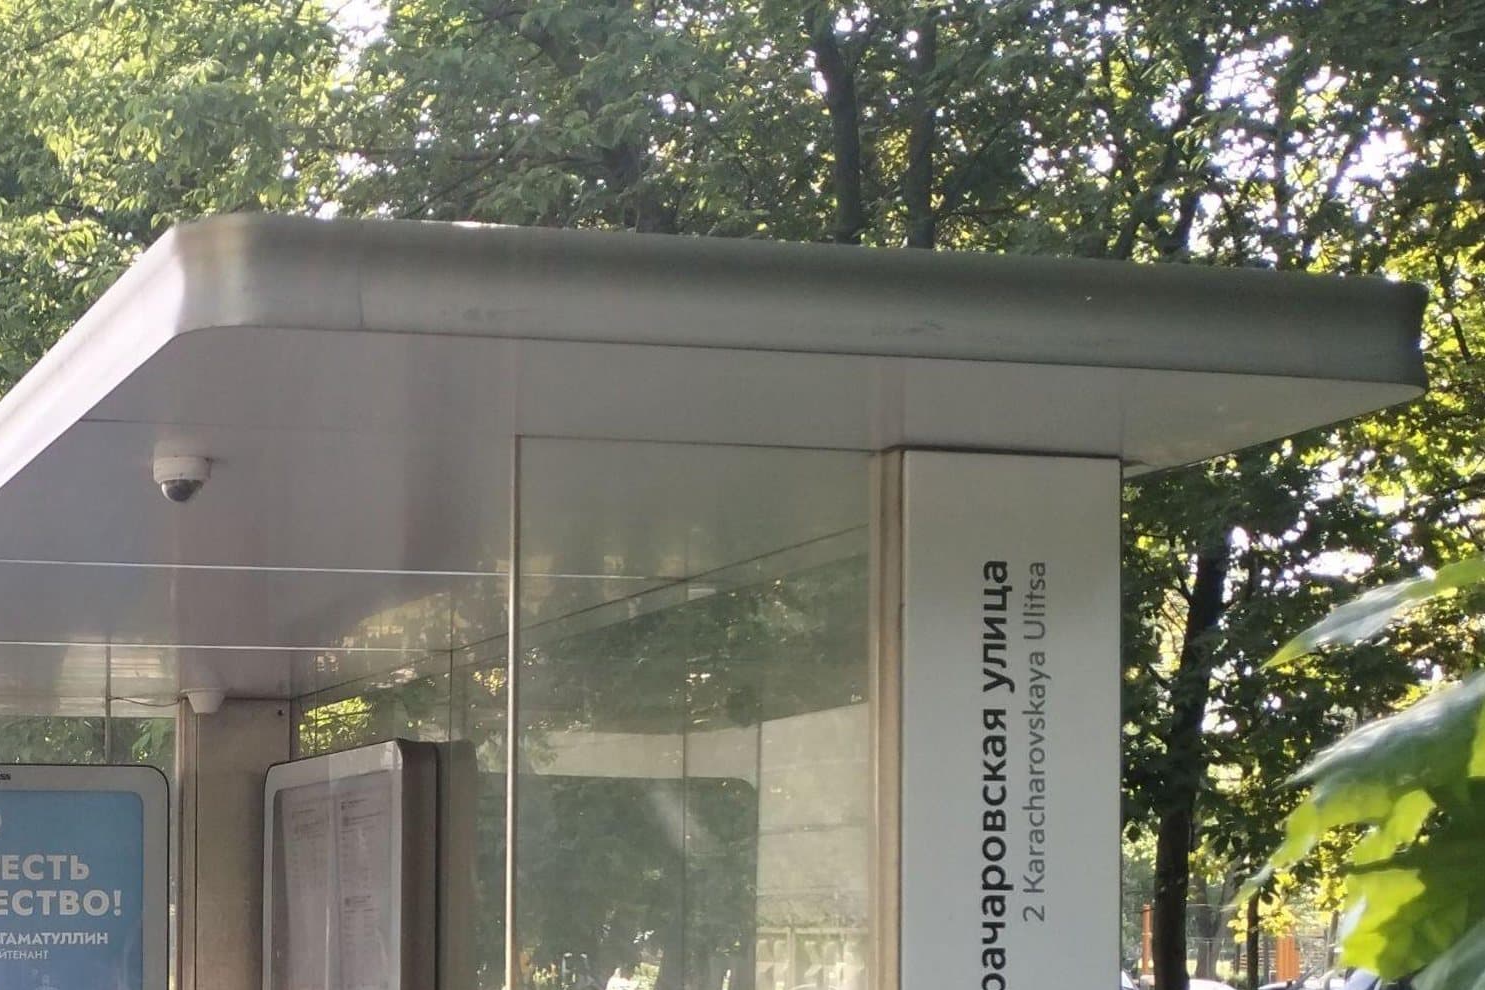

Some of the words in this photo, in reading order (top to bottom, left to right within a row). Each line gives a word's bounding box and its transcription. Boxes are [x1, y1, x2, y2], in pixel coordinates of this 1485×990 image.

[982, 560, 1016, 695] улица
[1022, 562, 1046, 640] Ulitsa
[1021, 651, 1052, 894] Karacharovskaya
[1022, 905, 1046, 923] 2
